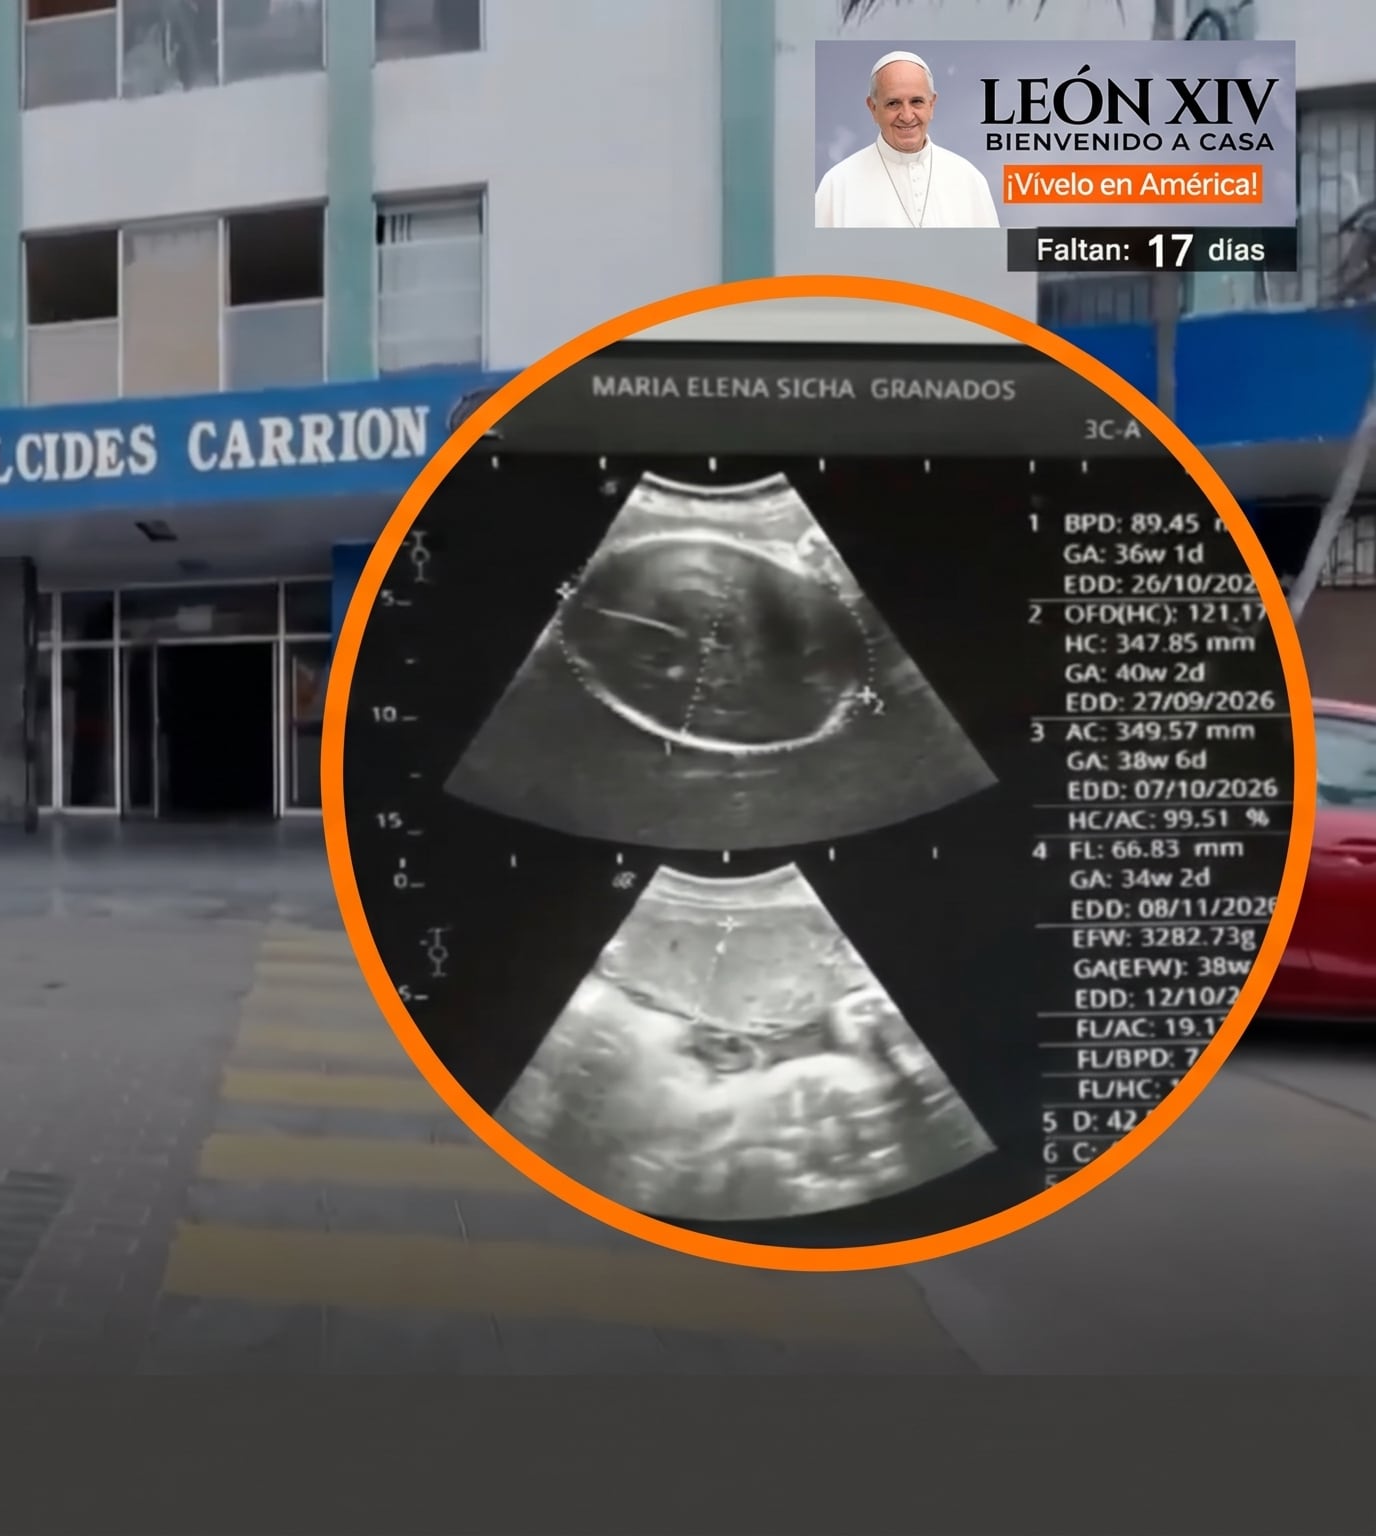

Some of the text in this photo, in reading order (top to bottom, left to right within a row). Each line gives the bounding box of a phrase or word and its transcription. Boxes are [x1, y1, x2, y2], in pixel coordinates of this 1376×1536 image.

[593, 376, 1015, 400] MARIA ELENA SICHA GRANADOS
[188, 406, 432, 470] CARRION
[1030, 514, 1037, 531] 1
[1065, 514, 1121, 533] BPD:
[1131, 514, 1199, 533] 89.45
[1064, 543, 1203, 564] GA: 36w 1d
[1065, 575, 1121, 593] EDD:
[1029, 605, 1041, 623] 2
[1065, 603, 1177, 625] OFD(HC):
[1066, 633, 1255, 653] HC: 347.85 mm
[1065, 663, 1205, 682] GA: 40w 2d
[1067, 691, 1275, 712] EDD: 27/09/2026
[372, 706, 397, 722] 10
[1032, 721, 1254, 742] 3 AC: 349.57 mm
[1067, 750, 1206, 770] GA: 38w 6d
[1068, 779, 1277, 800] EDD: 07/10/2026
[376, 812, 403, 828] 15
[1069, 808, 1269, 829] HC/AC: 99.51 %
[1033, 840, 1243, 860] 4 FL: 66.83 mm
[1070, 867, 1210, 889] GA: 34w 2d
[1072, 900, 1129, 919] EDD:
[1073, 927, 1257, 951] EFW: 3282.73g
[1074, 957, 1252, 979] GA(EFW): 38w
[1076, 989, 1133, 1008] EDD:
[1077, 1017, 1226, 1038] FL/AC: 19.1
[1078, 1048, 1175, 1068] FL/BPD:
[1079, 1079, 1161, 1100] FL/HC:
[1043, 1112, 1057, 1132] 5
[1074, 1111, 1097, 1131] D:
[1043, 1142, 1057, 1163] 6
